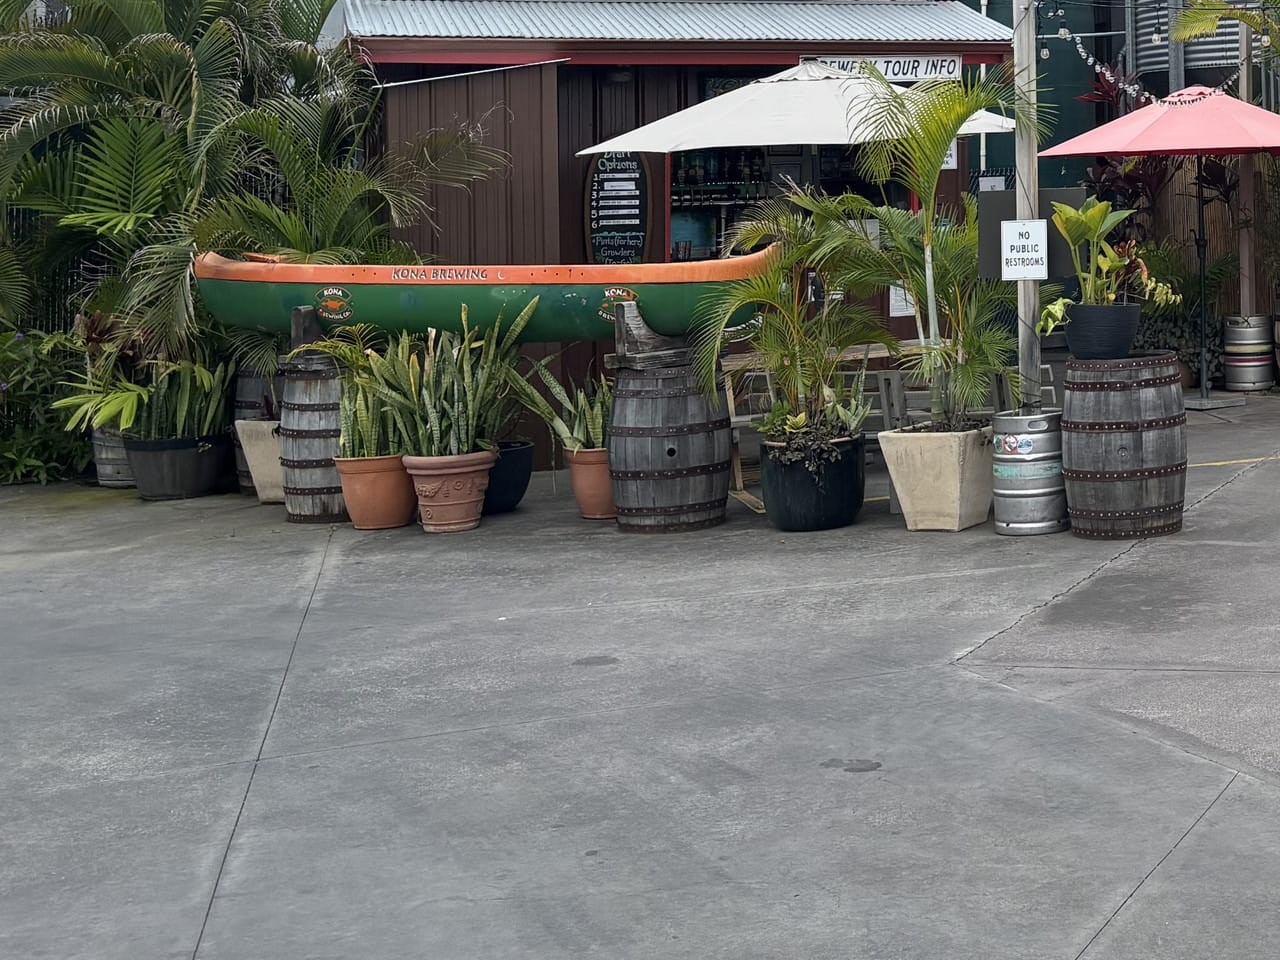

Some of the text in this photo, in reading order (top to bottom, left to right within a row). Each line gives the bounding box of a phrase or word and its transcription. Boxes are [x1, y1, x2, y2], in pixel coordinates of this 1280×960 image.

[884, 60, 920, 78] TOUR
[924, 59, 957, 76] INFO
[597, 158, 638, 172] Options
[1018, 231, 1031, 240] NO
[1010, 244, 1039, 253] PUBLIC
[1005, 256, 1045, 268] RESTROOMS
[391, 268, 488, 281] KONA BREWING
[323, 288, 343, 297] KONA
